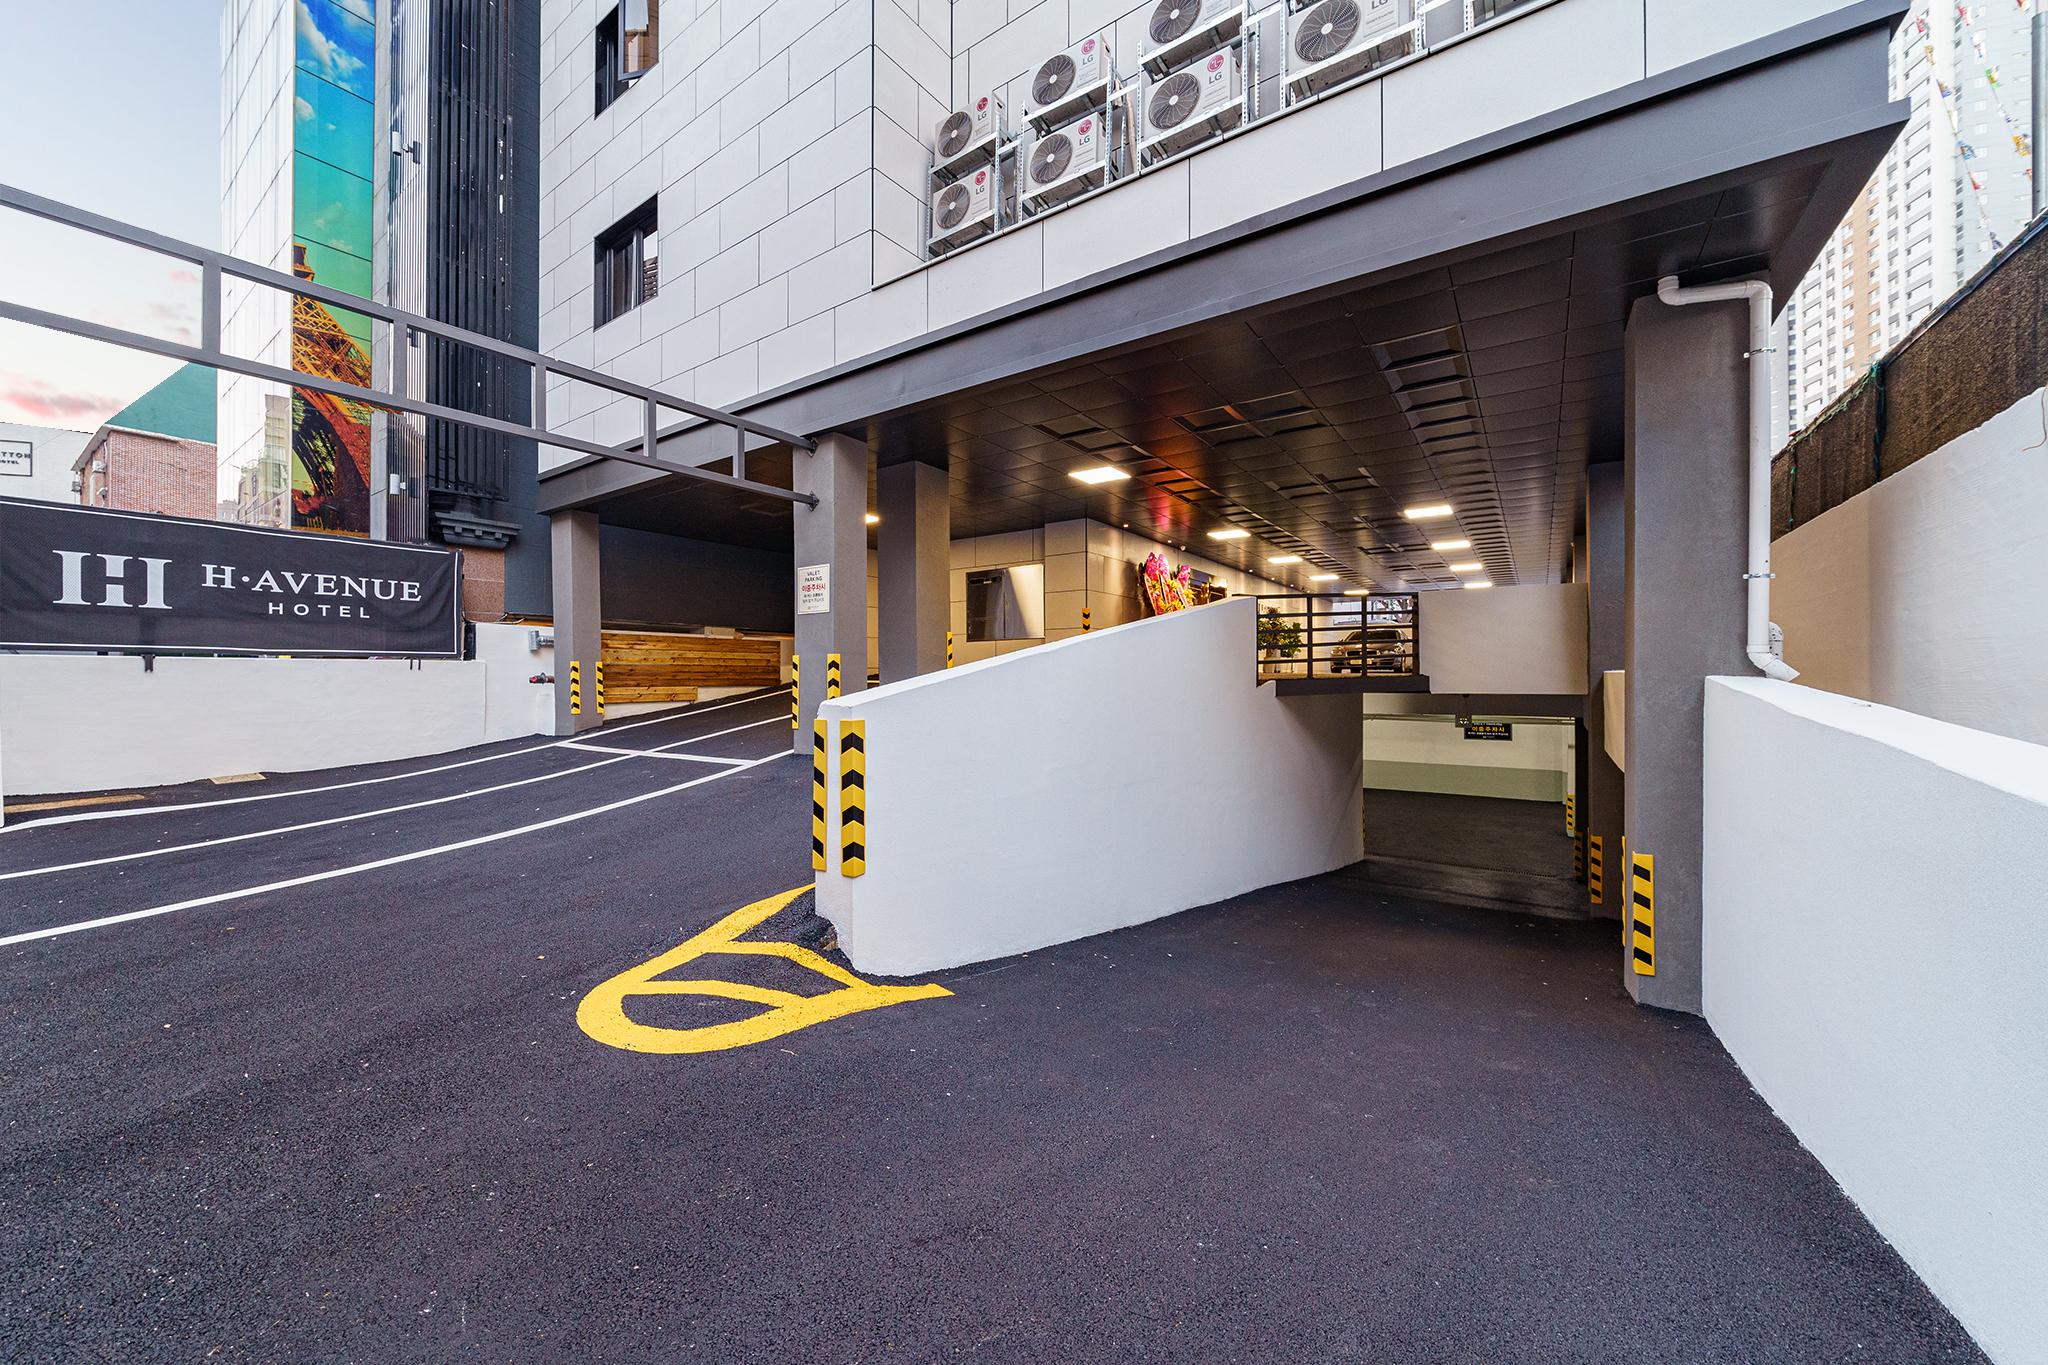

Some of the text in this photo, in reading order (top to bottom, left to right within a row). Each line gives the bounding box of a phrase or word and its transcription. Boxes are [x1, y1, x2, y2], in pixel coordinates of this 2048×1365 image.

[1082, 53, 1094, 66] LG
[1208, 71, 1223, 85] LG
[977, 109, 987, 122] LG
[1079, 134, 1090, 146] LG
[975, 184, 985, 196] LG
[268, 602, 371, 619] HOTEL
